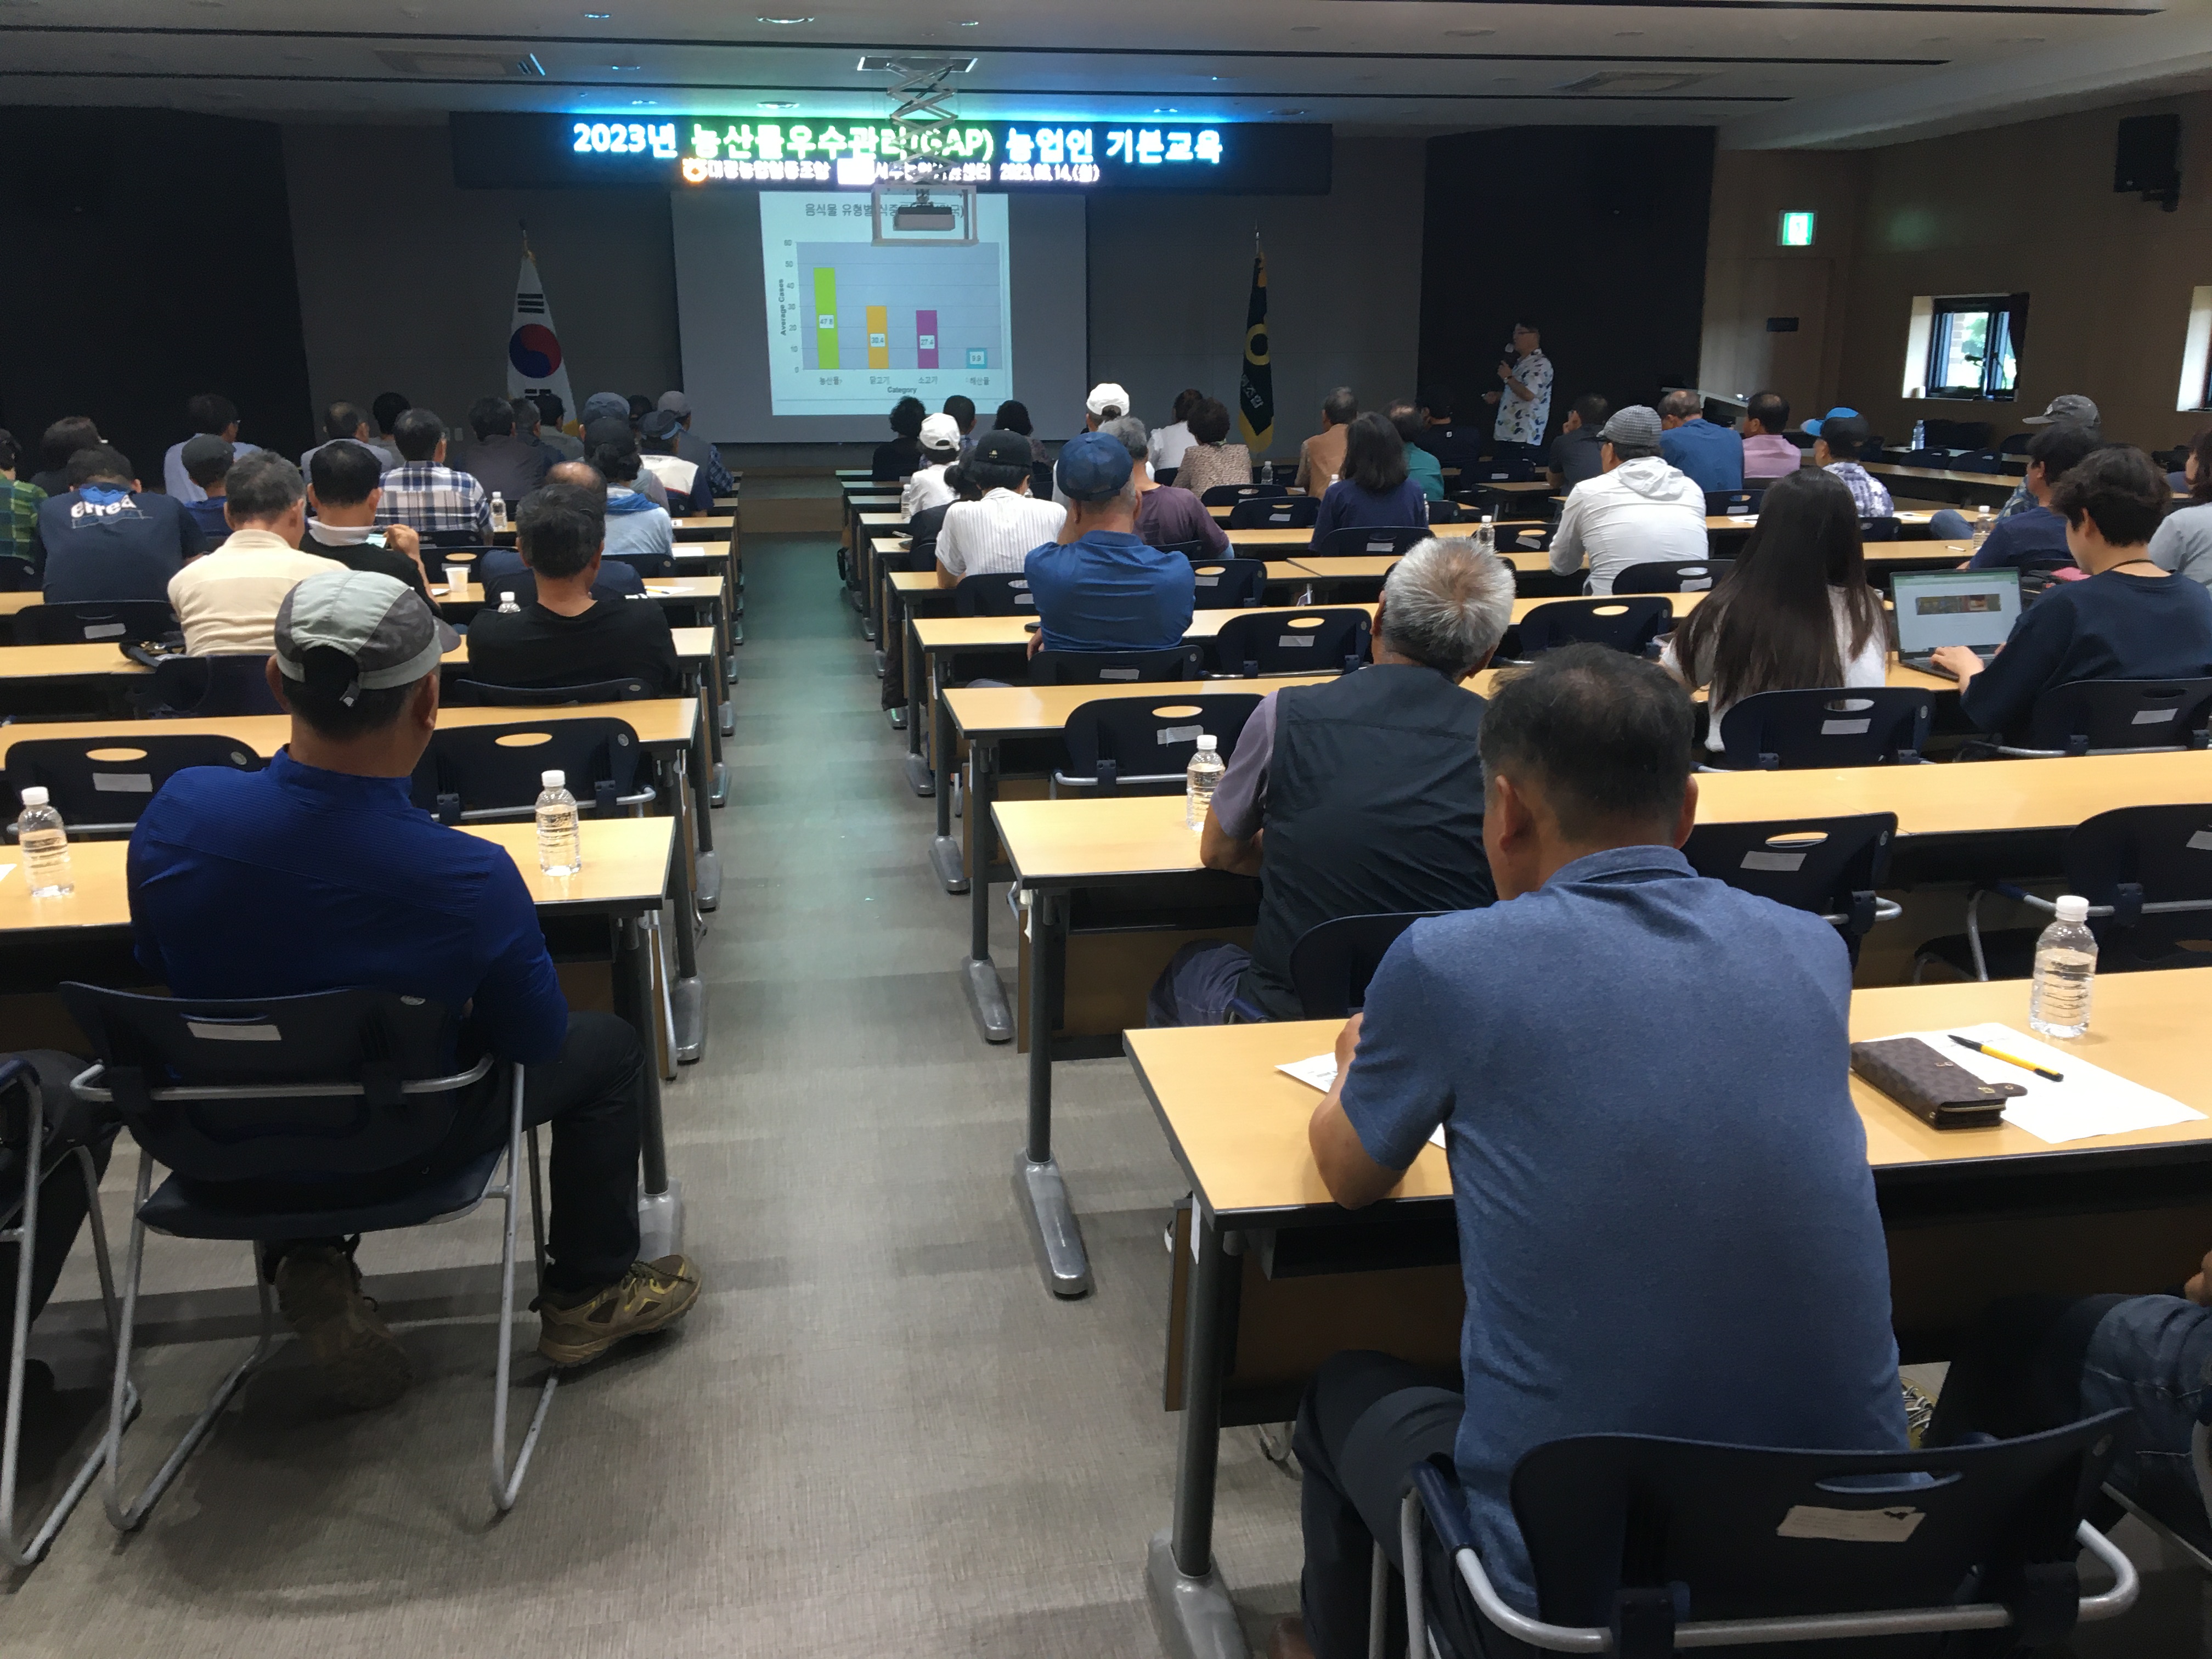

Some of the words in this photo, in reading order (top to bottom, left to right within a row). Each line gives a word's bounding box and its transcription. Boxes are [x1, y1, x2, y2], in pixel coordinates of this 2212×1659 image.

[573, 122, 678, 158] 2023년
[1006, 127, 1094, 163] 농업인
[1106, 129, 1223, 163] 기본교육
[805, 204, 837, 217] 음식물
[842, 204, 872, 217] 유형별
[918, 376, 938, 385] 소고기
[887, 386, 917, 394] Category
